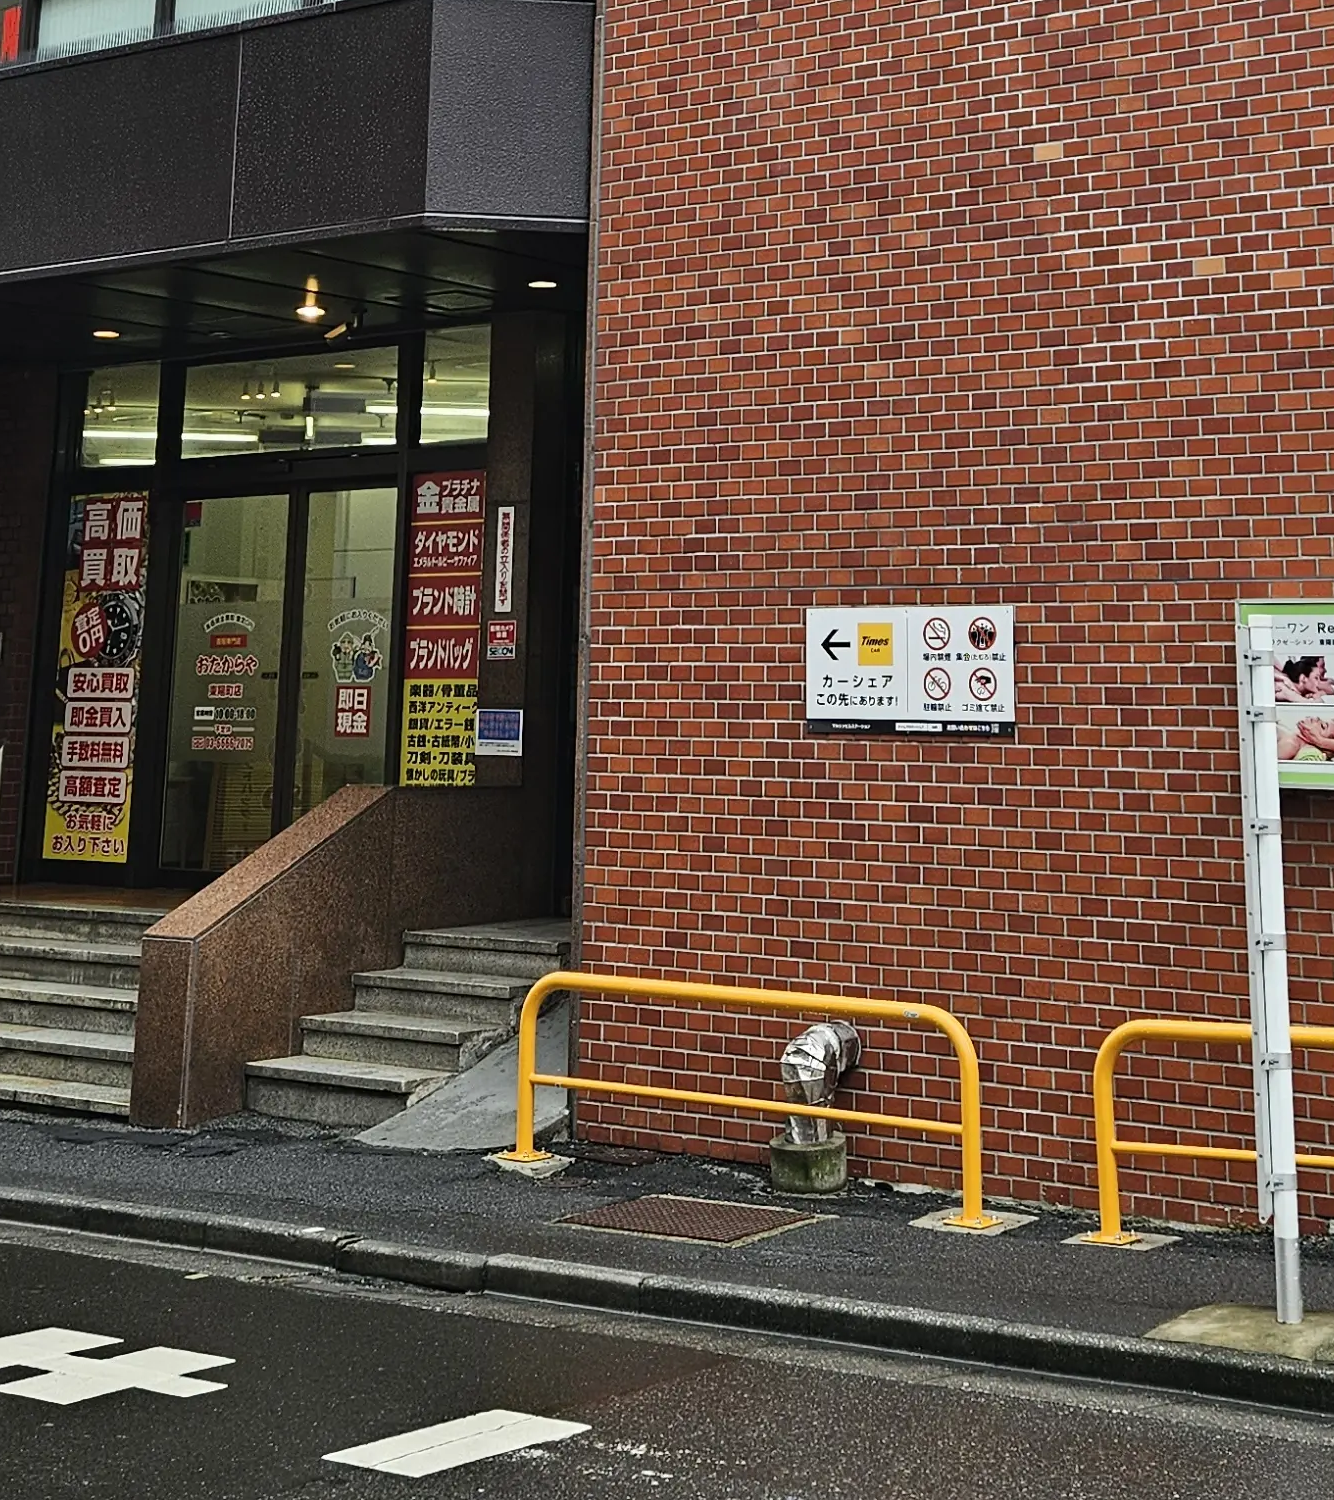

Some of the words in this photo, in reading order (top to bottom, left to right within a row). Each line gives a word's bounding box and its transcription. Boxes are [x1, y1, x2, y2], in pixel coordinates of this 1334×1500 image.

[416, 480, 441, 514] 金
[441, 477, 481, 496] プラチナ
[440, 495, 481, 515] 貴金属
[83, 500, 145, 542] 高価
[414, 528, 479, 555] ダイヤモンド
[80, 547, 141, 587] 買取
[412, 585, 477, 617] ブランド時計
[74, 606, 102, 636] 査定
[78, 627, 105, 654] 0円
[860, 635, 890, 647] Times
[196, 654, 259, 676] おたからや
[409, 637, 474, 671] ブランドバッグ
[72, 672, 130, 694] 安心買取
[822, 674, 893, 689] カーシェア
[337, 688, 368, 711] 即日
[816, 692, 899, 707] この先にあります!
[336, 711, 368, 734] 現金
[66, 740, 124, 764] 手数料無料
[63, 775, 122, 798] 高額査定
[65, 813, 114, 832] お気軽に
[51, 835, 126, 856] お入り下さい
